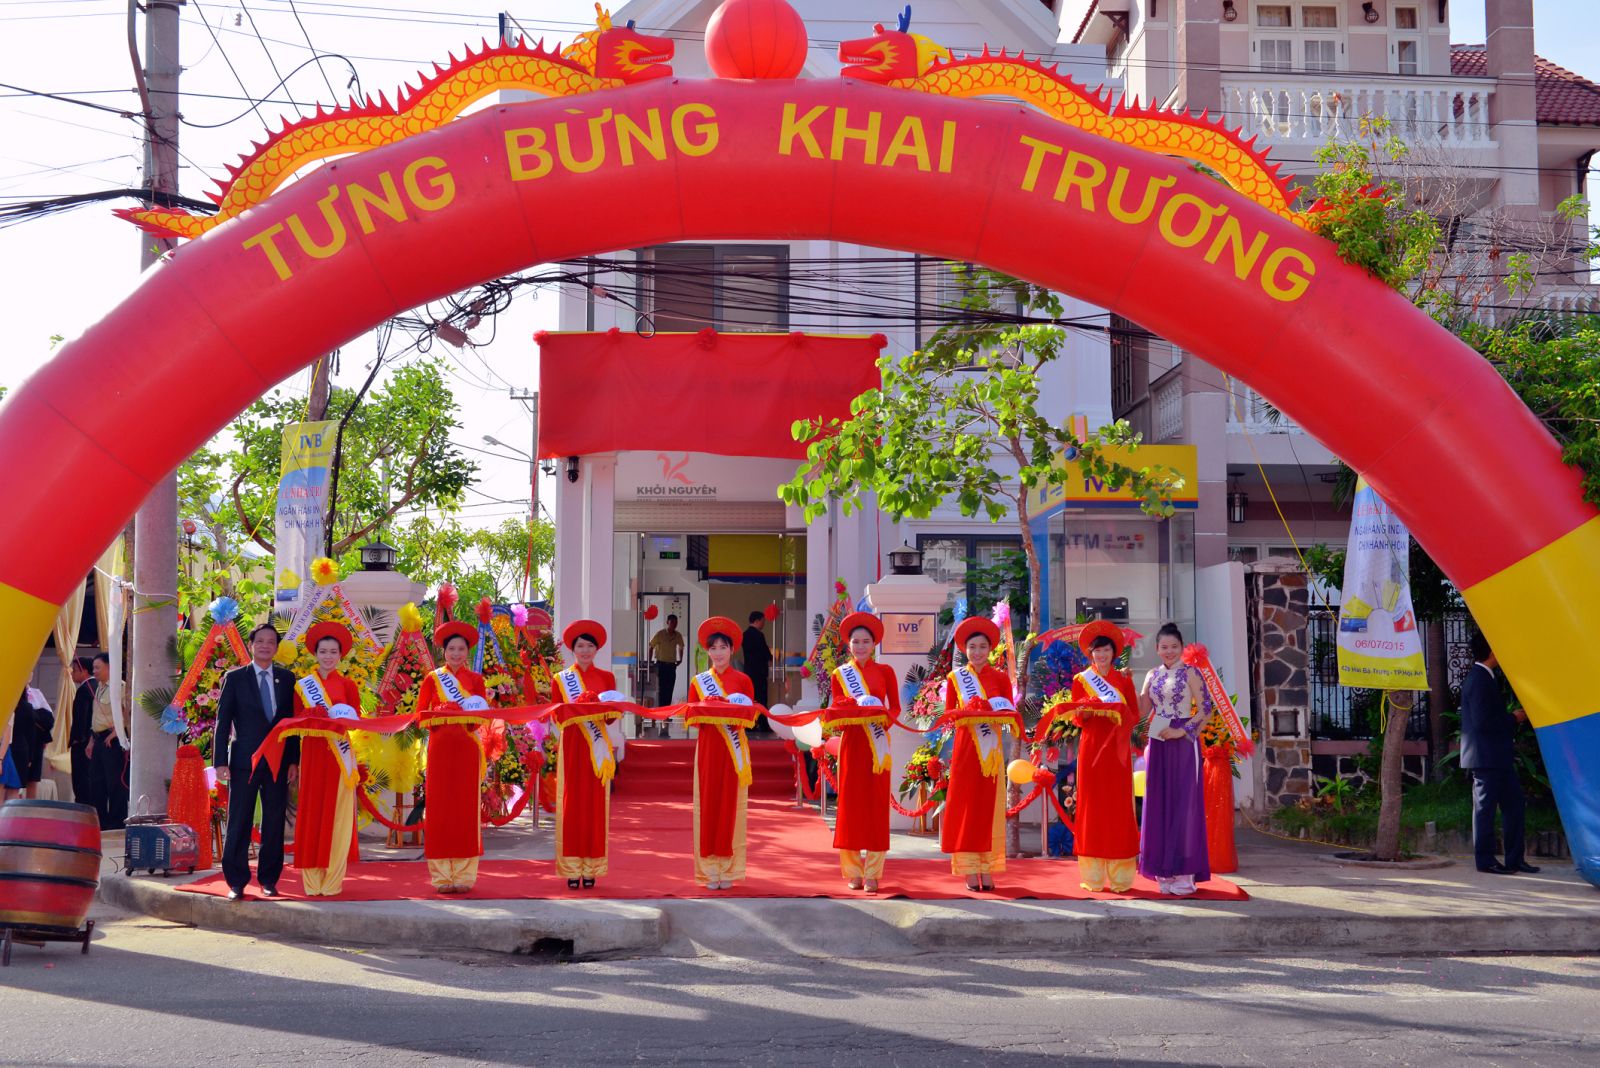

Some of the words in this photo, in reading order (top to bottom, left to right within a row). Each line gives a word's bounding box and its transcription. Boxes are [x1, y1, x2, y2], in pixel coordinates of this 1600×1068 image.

[505, 102, 720, 182] BỪNG
[777, 102, 957, 173] KHAI
[1020, 136, 1316, 301] TRƯƠNG
[1084, 475, 1121, 493] IV
[896, 622, 919, 633] IVB
